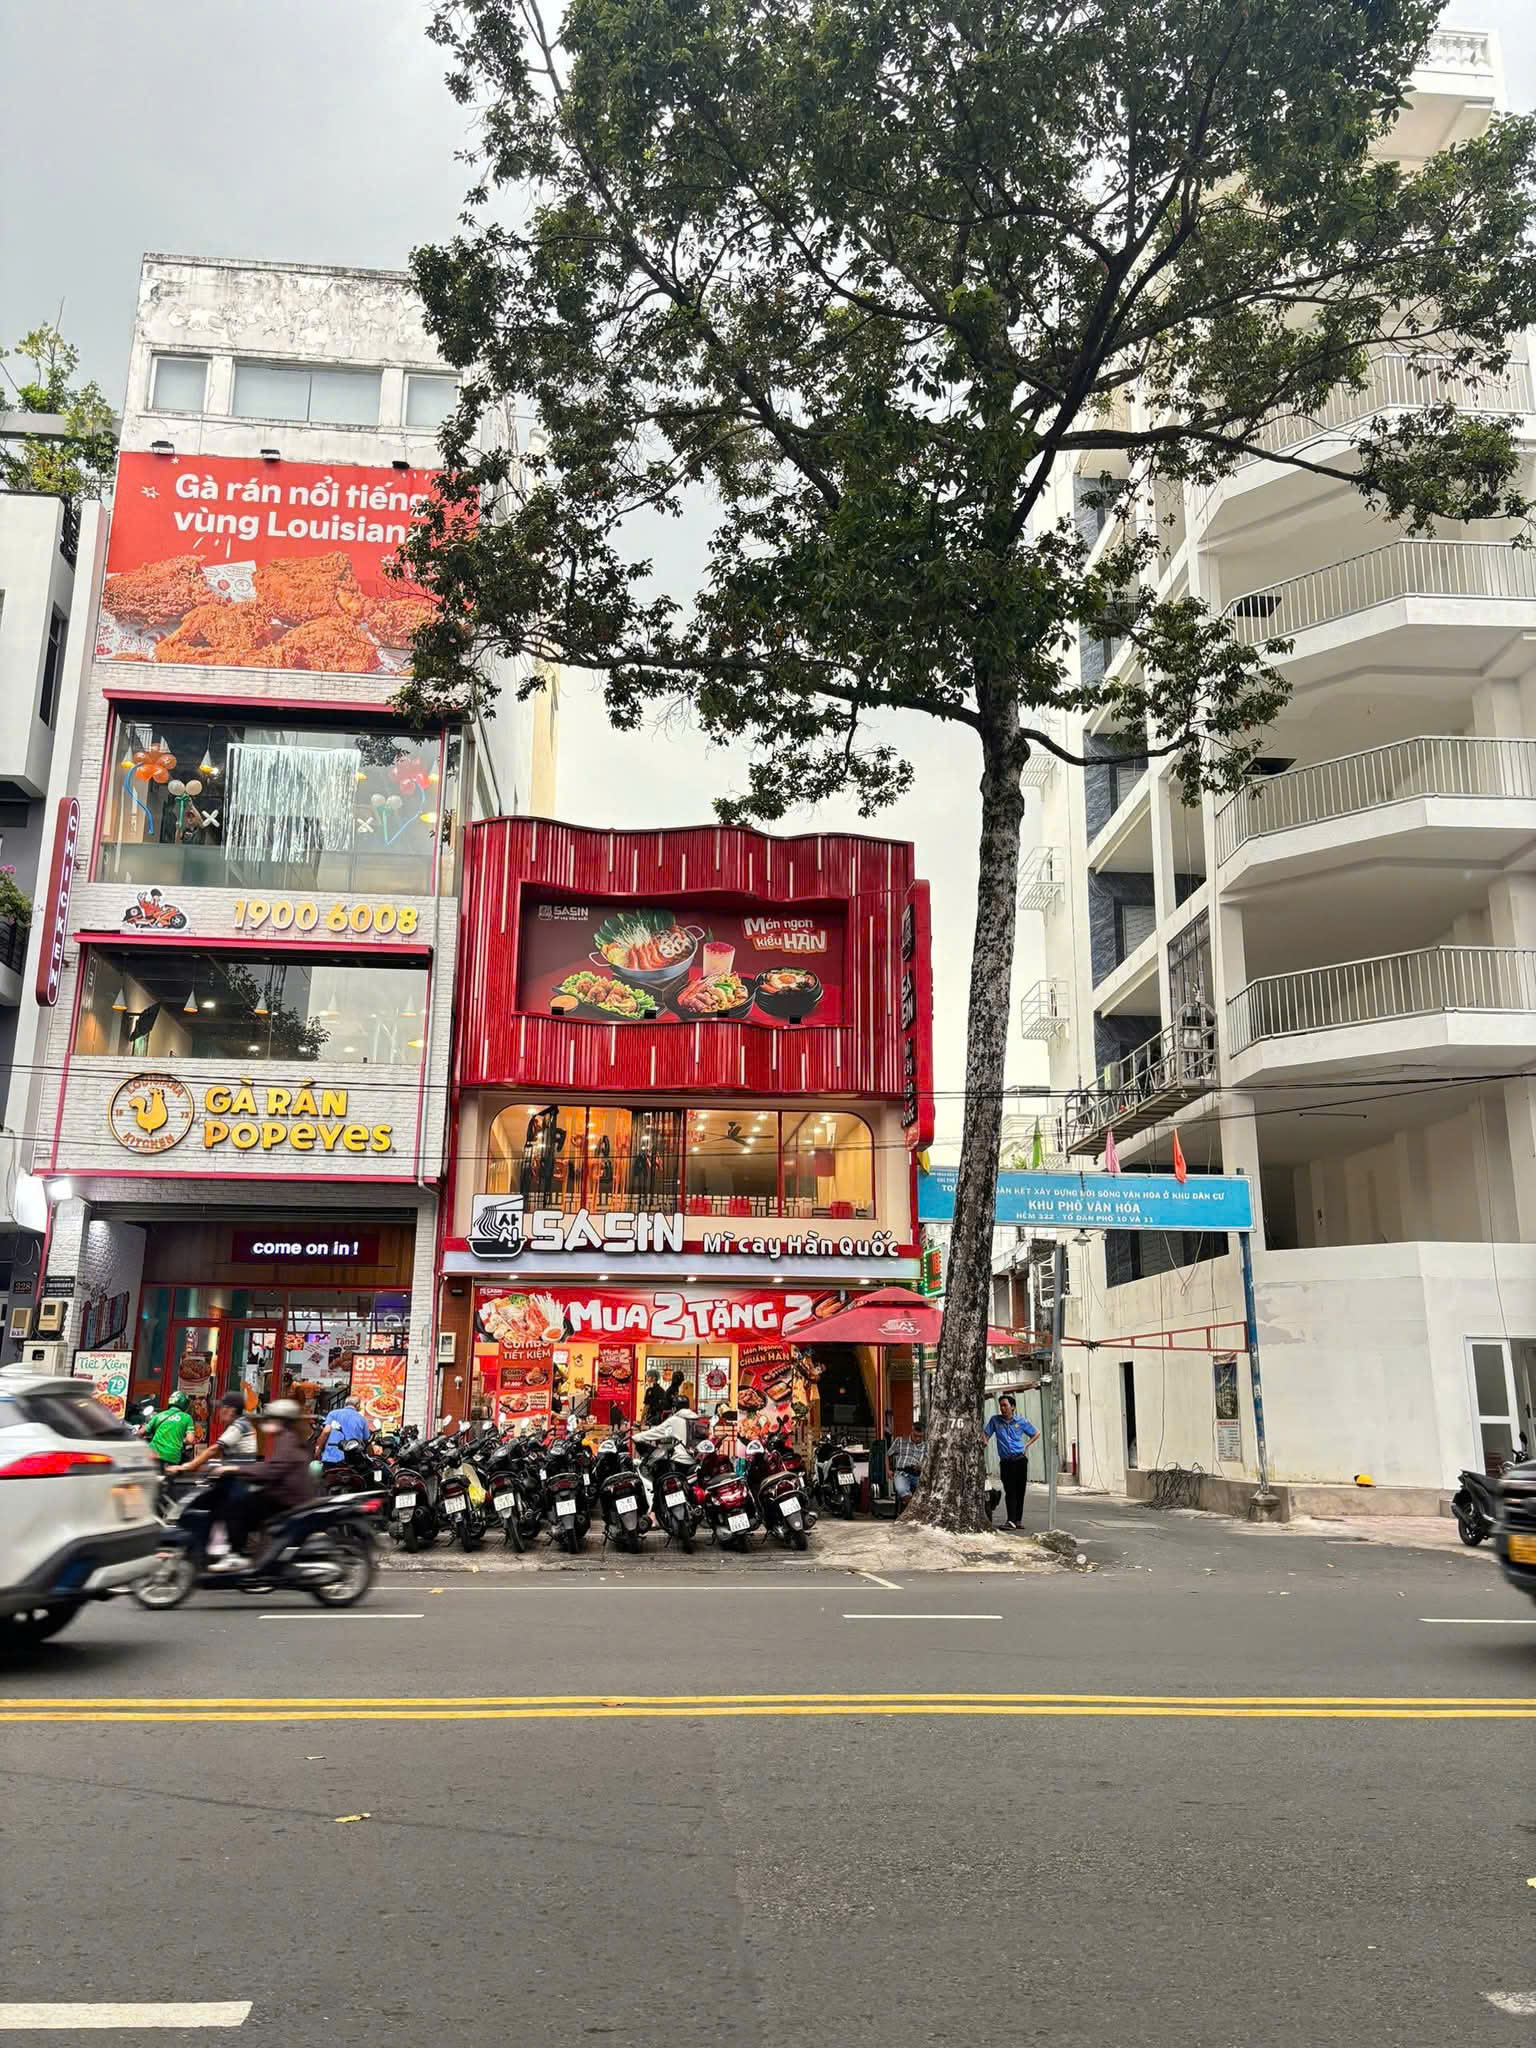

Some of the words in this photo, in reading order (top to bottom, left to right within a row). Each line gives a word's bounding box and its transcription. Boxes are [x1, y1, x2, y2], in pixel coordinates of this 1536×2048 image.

[175, 474, 218, 499] Gà
[226, 478, 281, 504] rán
[289, 475, 339, 508] nổi
[174, 507, 259, 541] vùng
[49, 815, 77, 987] CHICKEN
[554, 905, 588, 916] SASIN
[233, 897, 319, 931] 1900
[327, 903, 420, 935] 6008
[744, 917, 780, 936] Món
[783, 920, 814, 931] ngon
[756, 933, 782, 947] kiểu
[783, 929, 826, 950] HÀN
[204, 1077, 257, 1115] GÀ
[266, 1077, 349, 1117] RÁN
[1028, 1200, 1054, 1211] KHU
[1058, 1197, 1083, 1212] PHỐ
[1087, 1199, 1112, 1213] VĂN
[1115, 1200, 1141, 1214] HÓA
[1172, 1191, 1190, 1200] KHU
[530, 1208, 684, 1253] SASIN
[252, 1242, 302, 1255] come
[306, 1243, 328, 1255] on
[333, 1241, 350, 1255] in
[703, 1231, 735, 1254] Mì
[737, 1237, 781, 1260] cay
[788, 1230, 833, 1256] Hàn
[838, 1230, 899, 1257] Quốc
[569, 1300, 650, 1332] MUA
[651, 1292, 685, 1341] 2
[686, 1299, 780, 1337] TẶNG
[782, 1294, 814, 1337] 2
[355, 1356, 376, 1372] 89
[503, 1349, 524, 1360] TIẾT
[526, 1348, 551, 1361] KIỆM
